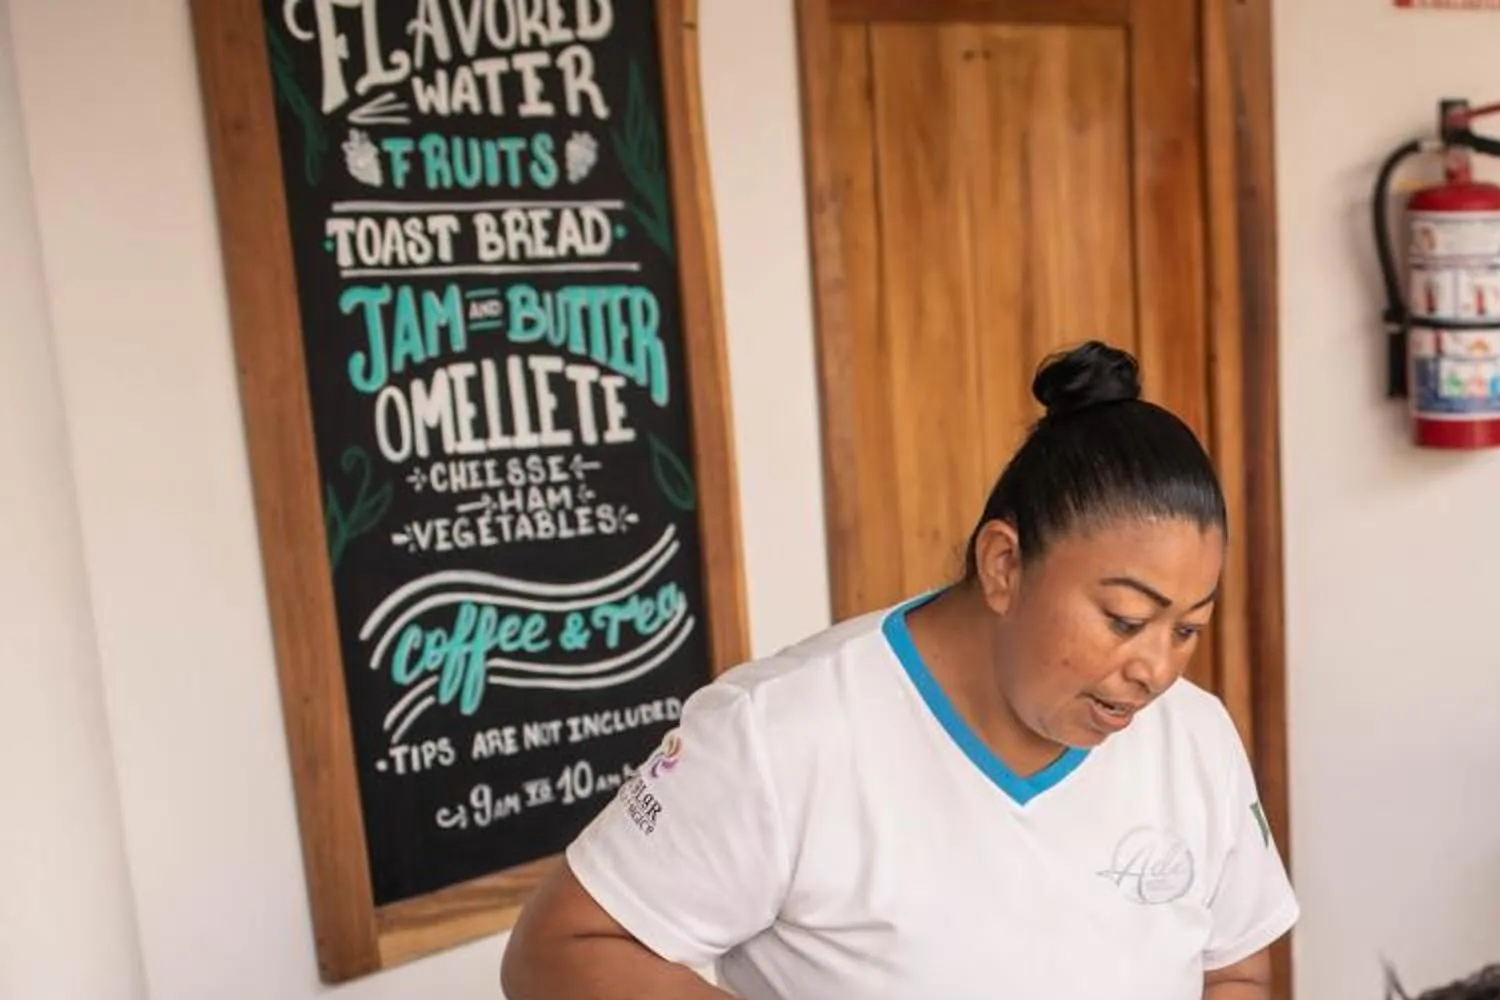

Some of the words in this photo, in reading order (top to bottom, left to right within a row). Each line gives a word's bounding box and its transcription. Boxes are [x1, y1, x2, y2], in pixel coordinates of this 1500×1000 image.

[283, 0, 614, 115] FLAVORED
[411, 44, 610, 119] WATER
[382, 132, 561, 190] FRUITS
[326, 212, 460, 266] TOAST
[473, 207, 614, 263] BREAD
[340, 282, 467, 393] JAM
[469, 299, 503, 320] AND
[507, 283, 669, 407] BUTTER
[375, 355, 637, 462] OMELLETE
[430, 455, 571, 493] CHEESSE
[501, 488, 574, 513] HAM
[411, 504, 618, 552] VEGETABLES
[391, 598, 552, 716] Coffee
[559, 611, 592, 651] &
[590, 581, 684, 650] Tea
[389, 736, 456, 775] TIPS
[472, 725, 519, 760] ARE
[523, 720, 563, 751] NOT
[566, 697, 684, 744] INCLUDED
